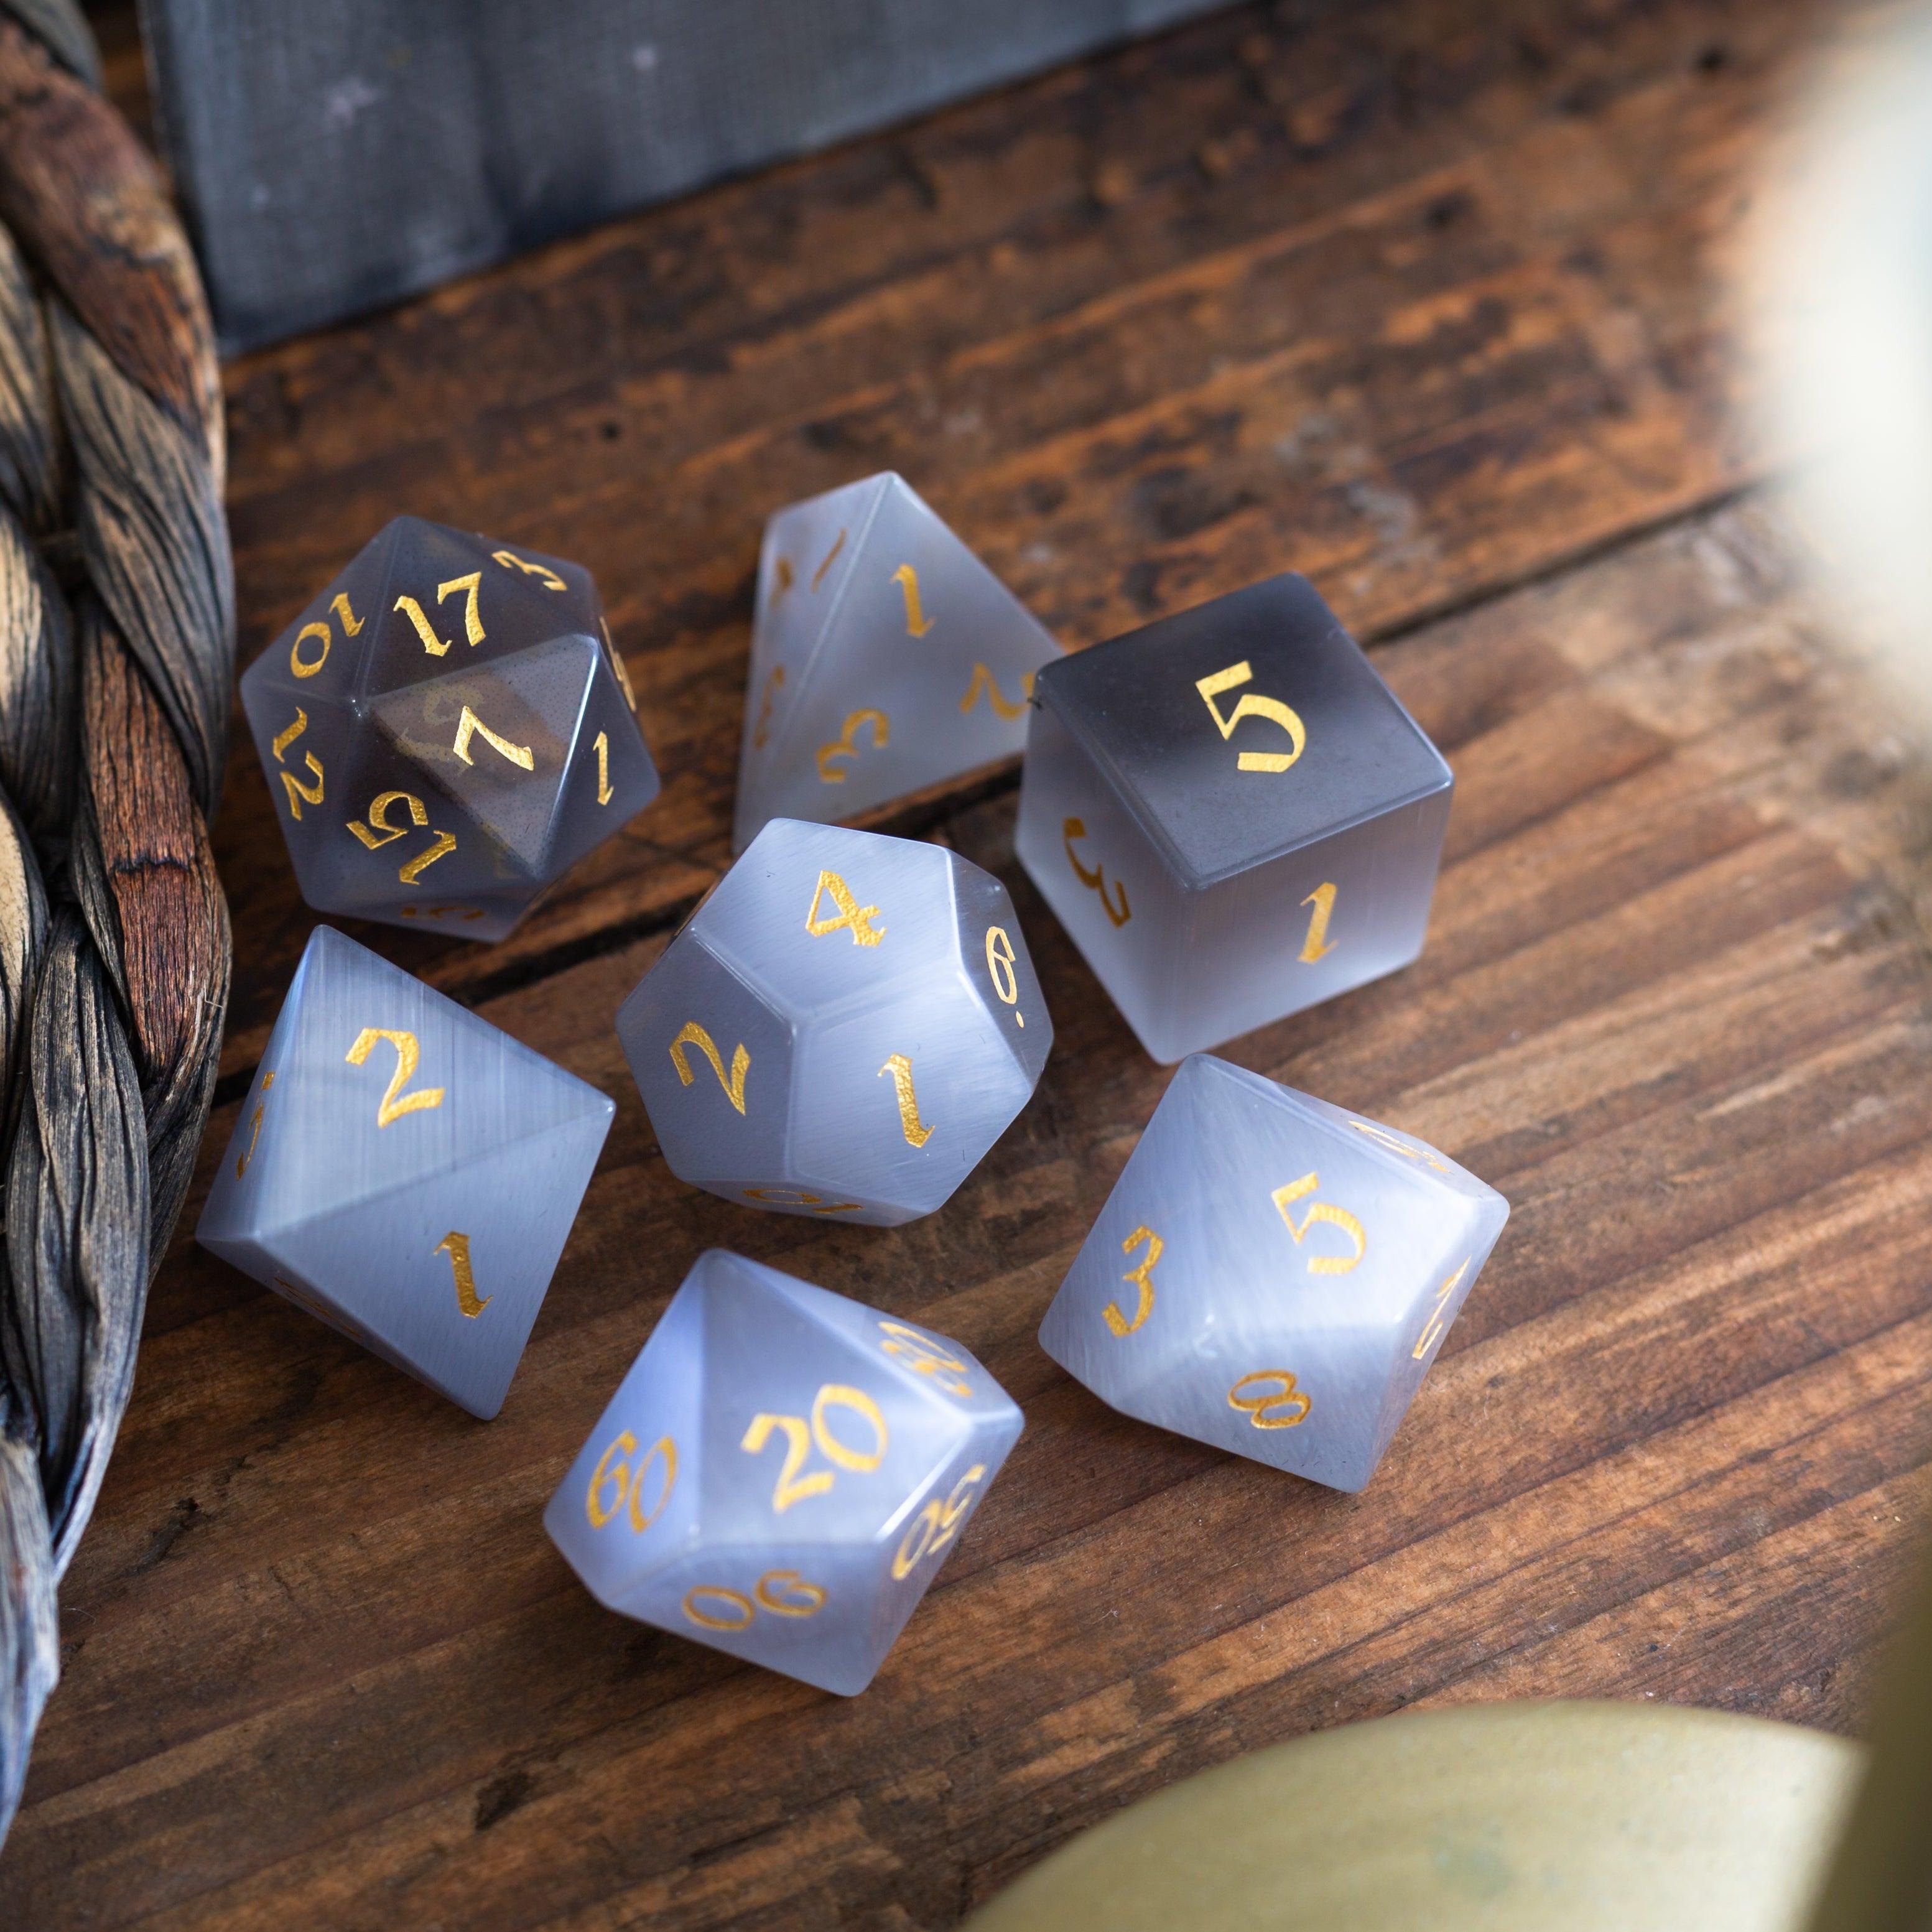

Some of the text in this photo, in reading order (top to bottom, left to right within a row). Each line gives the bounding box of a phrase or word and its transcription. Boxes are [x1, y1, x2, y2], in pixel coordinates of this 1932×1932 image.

[393, 571, 486, 656] 17
[491, 550, 568, 591] 3
[889, 564, 936, 638] 1
[290, 592, 365, 678] 10
[453, 705, 534, 771] 7
[815, 708, 890, 784] 3
[1195, 660, 1306, 773] 5
[272, 707, 324, 820] 12
[593, 731, 613, 806] 1
[346, 791, 457, 885] 15
[1064, 817, 1131, 928] 3
[805, 870, 886, 947] 4
[1298, 882, 1338, 964] 1
[345, 1027, 445, 1128] 2
[669, 1021, 751, 1115] 2
[877, 1053, 935, 1148] 1
[1271, 1171, 1366, 1275] 5
[433, 1231, 494, 1319] 1
[1102, 1225, 1164, 1337] 3
[1227, 1370, 1312, 1429] 8
[586, 1429, 679, 1534] 60
[741, 1384, 888, 1514] 20
